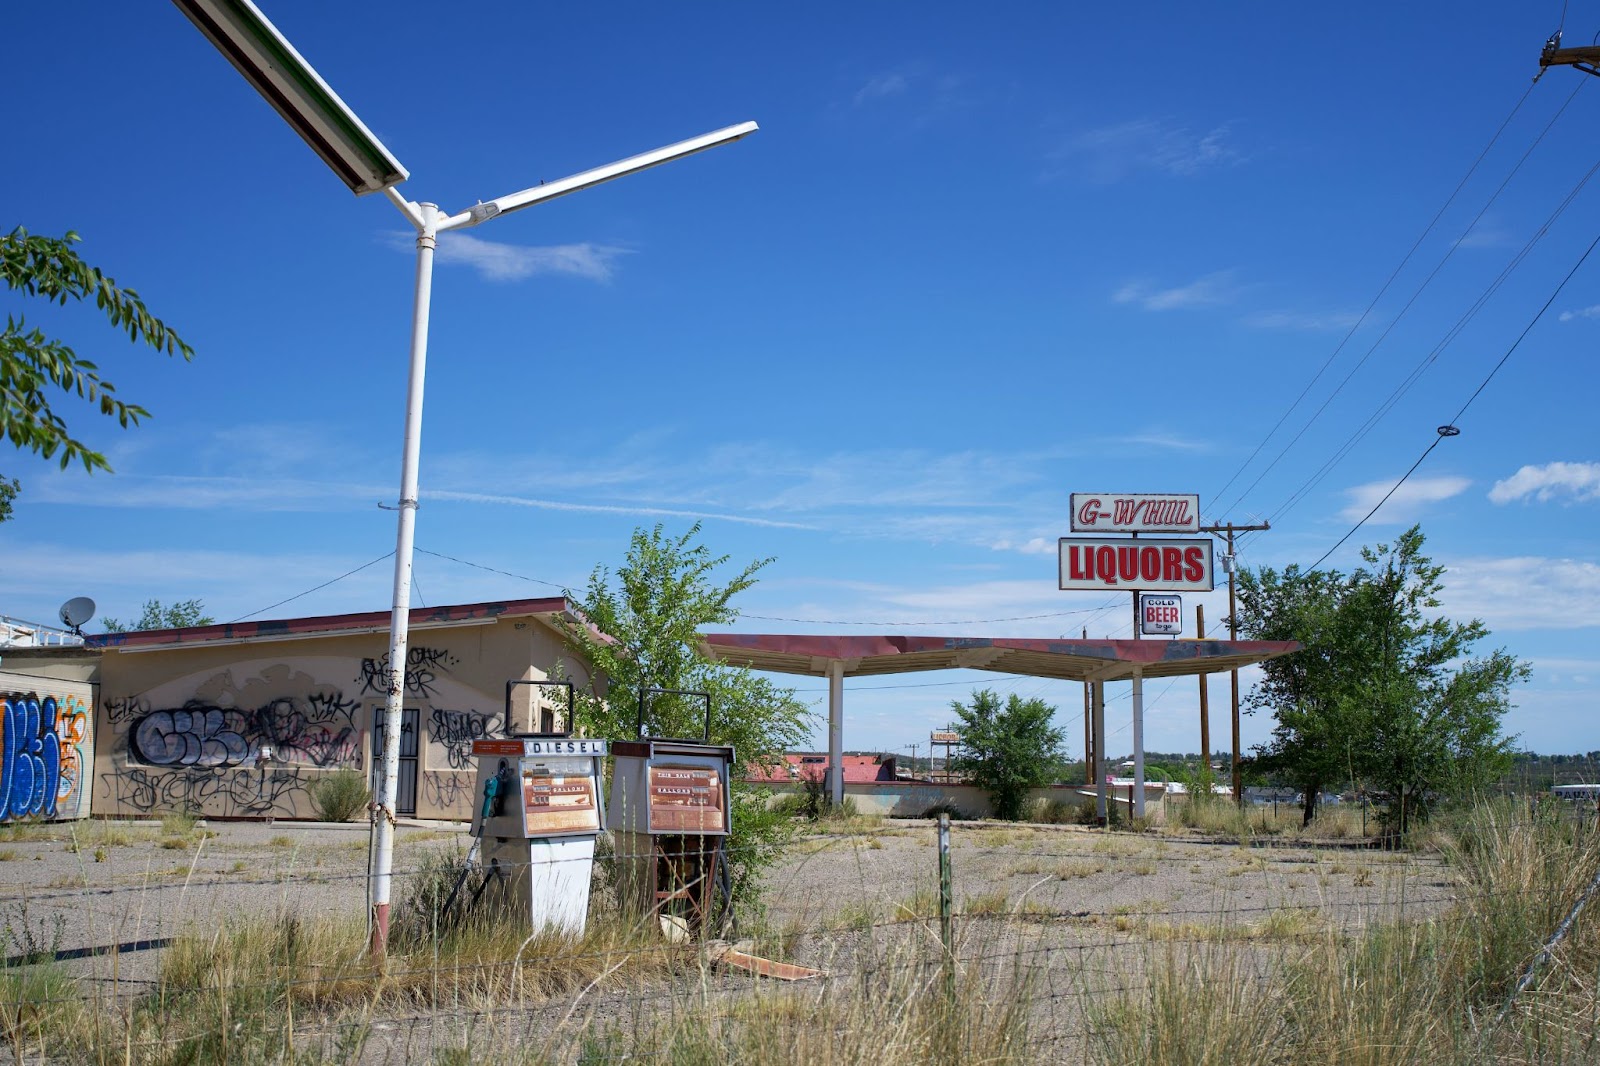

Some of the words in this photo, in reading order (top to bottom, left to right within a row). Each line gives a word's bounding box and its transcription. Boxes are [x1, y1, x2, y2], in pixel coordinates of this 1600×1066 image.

[1078, 499, 1194, 526] G-WHIL
[1069, 545, 1205, 585] LIQUORS
[1146, 607, 1179, 623] BEER
[533, 742, 599, 754] DIESEL
